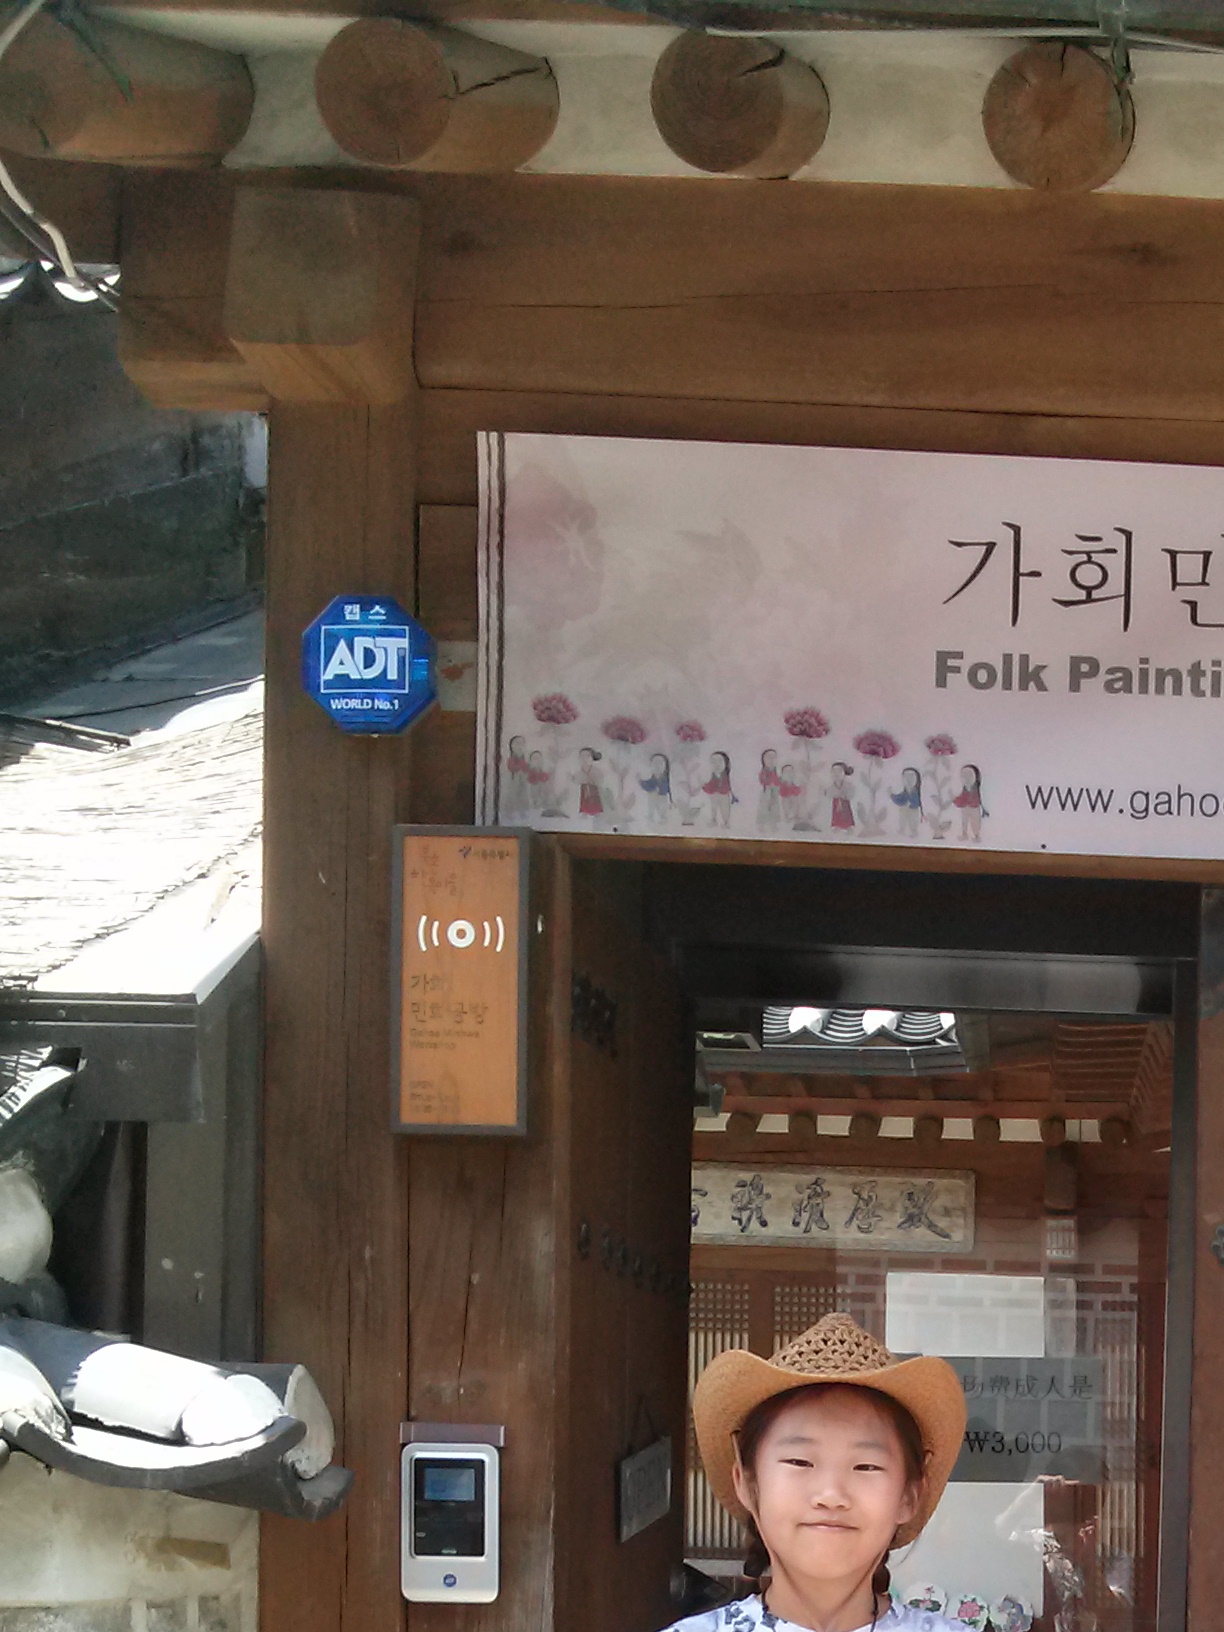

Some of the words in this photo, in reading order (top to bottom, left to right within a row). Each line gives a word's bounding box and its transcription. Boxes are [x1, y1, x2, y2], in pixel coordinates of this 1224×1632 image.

[323, 636, 408, 680] ADT
[934, 650, 1049, 693] Folk
[330, 698, 372, 710] WORLD
[374, 698, 399, 710] No.1
